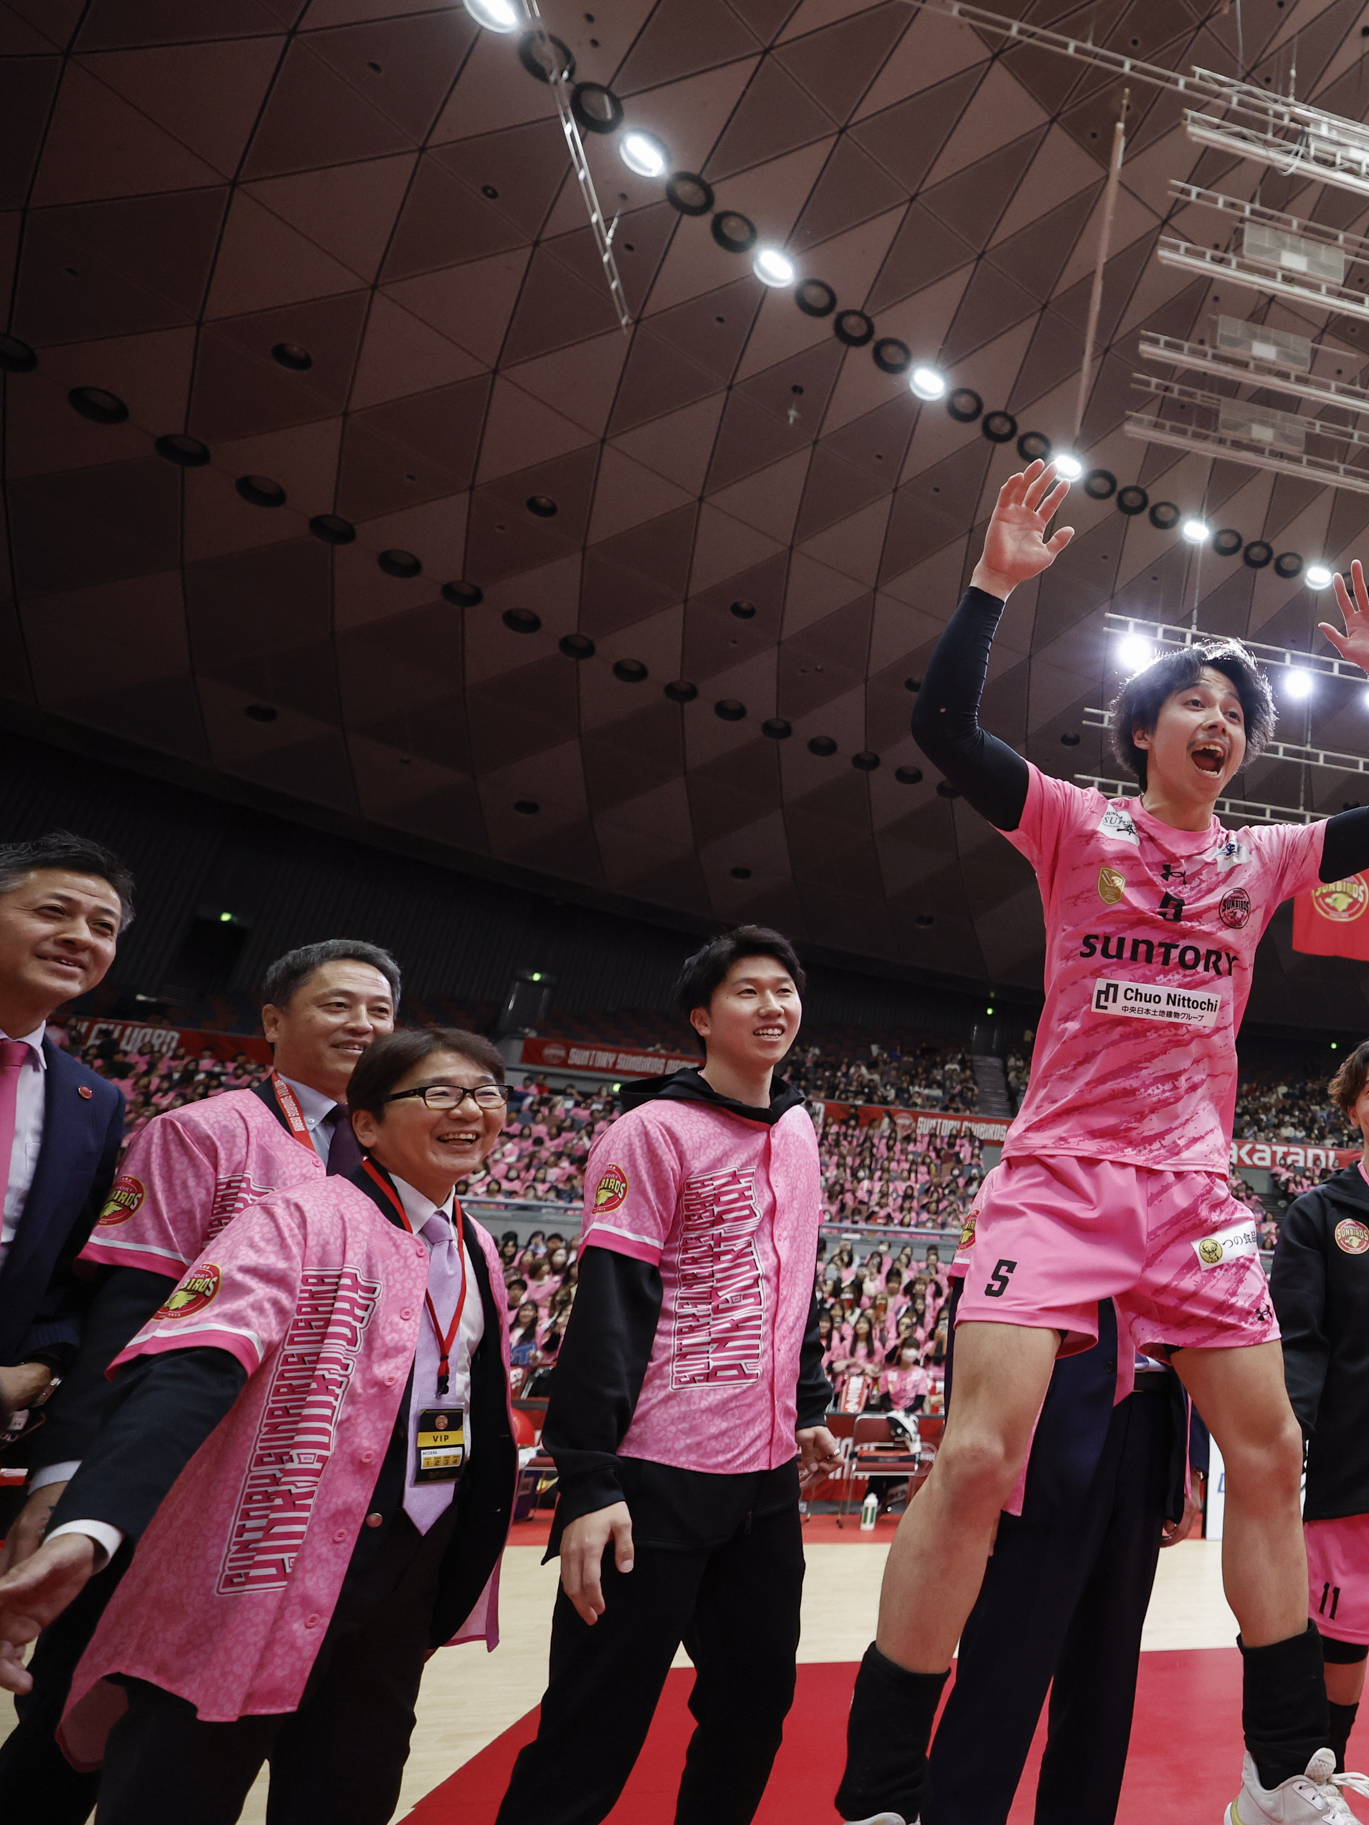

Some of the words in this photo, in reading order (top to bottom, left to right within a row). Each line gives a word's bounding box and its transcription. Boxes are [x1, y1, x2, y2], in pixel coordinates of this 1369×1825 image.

[1079, 934, 1240, 977] SUNTORY
[1123, 987, 1162, 1005] Chuo
[1166, 992, 1219, 1013] Nittochi
[1121, 1005, 1205, 1022] 中央日本土地建物グループ
[600, 1178, 627, 1199] BIRDS
[179, 1276, 219, 1297] BIRDS
[984, 1259, 1018, 1298] 5
[432, 1434, 449, 1442] VIP
[1319, 1581, 1341, 1621] 11
